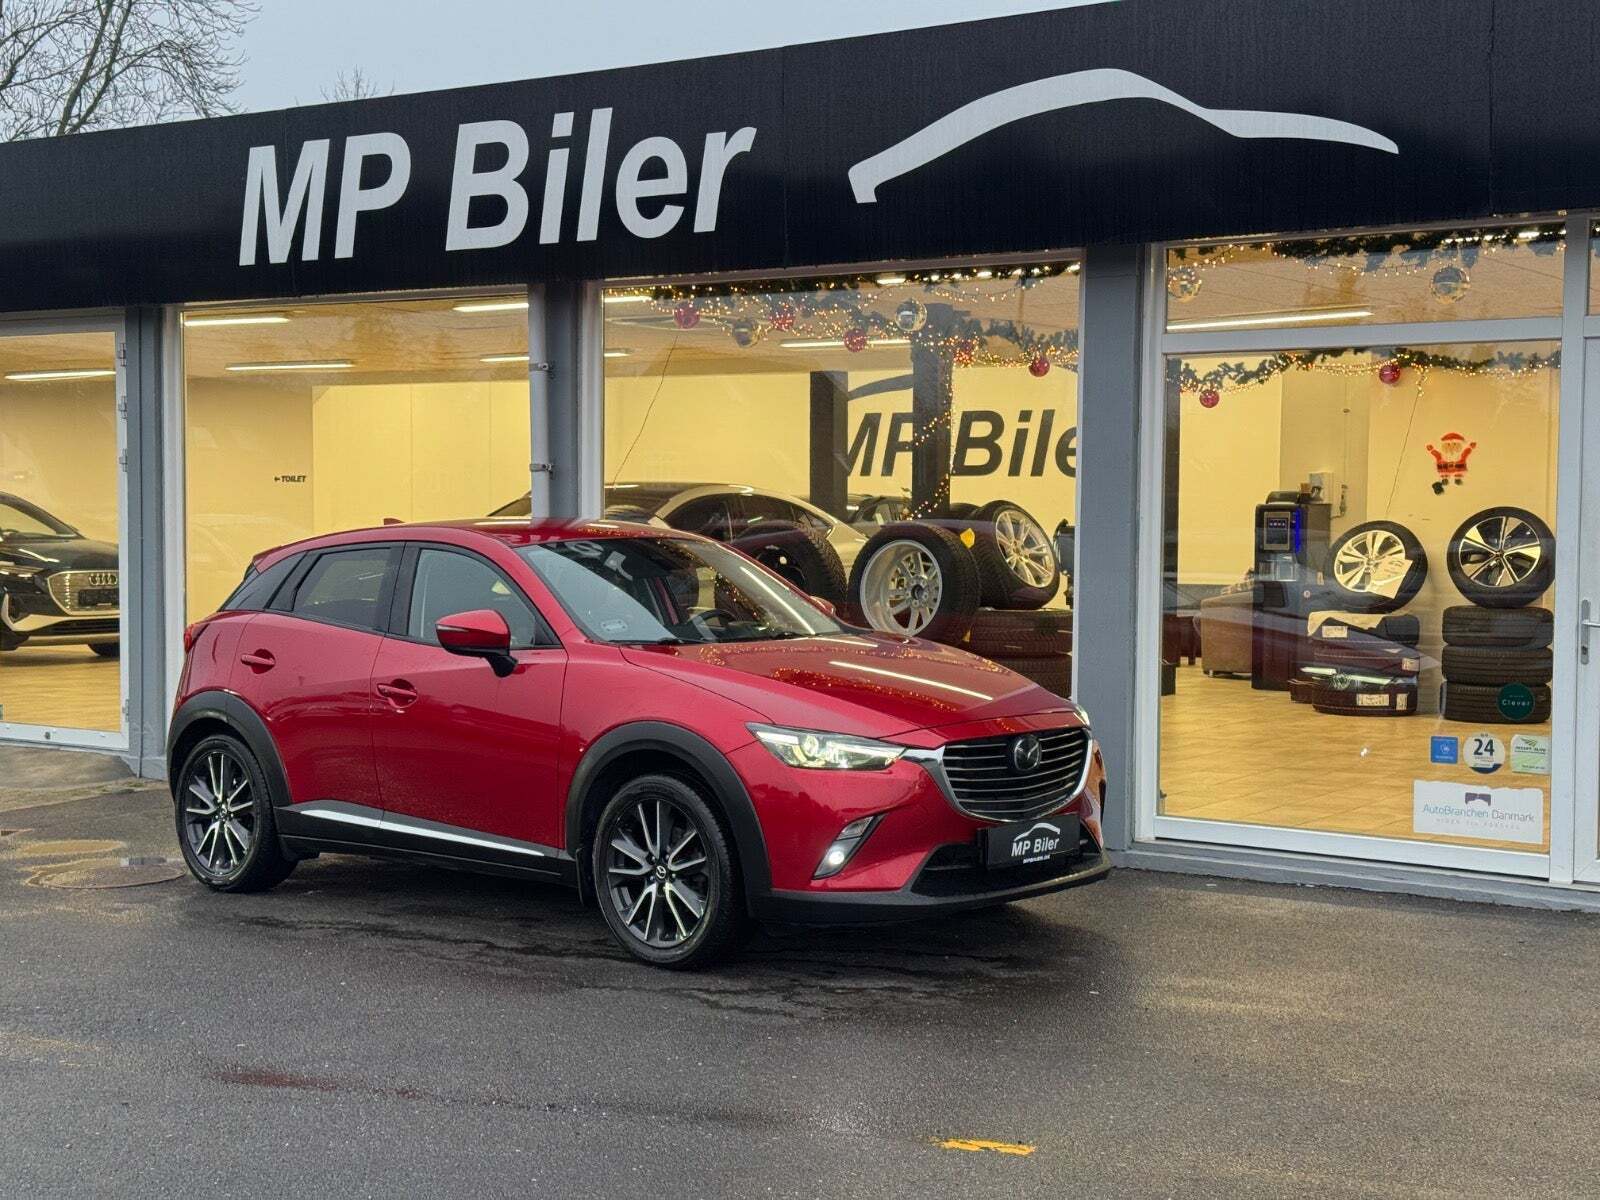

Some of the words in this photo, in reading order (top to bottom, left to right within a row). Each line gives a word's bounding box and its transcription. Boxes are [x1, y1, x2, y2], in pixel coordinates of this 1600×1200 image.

[239, 132, 411, 266] MP
[445, 107, 757, 251] Biler
[281, 475, 306, 483] TOILET
[1473, 738, 1495, 757] 24
[1423, 804, 1489, 819] AutoBranchen
[1491, 809, 1535, 823] Danmark
[1011, 840, 1031, 857] MP
[1033, 837, 1060, 853] Biler
